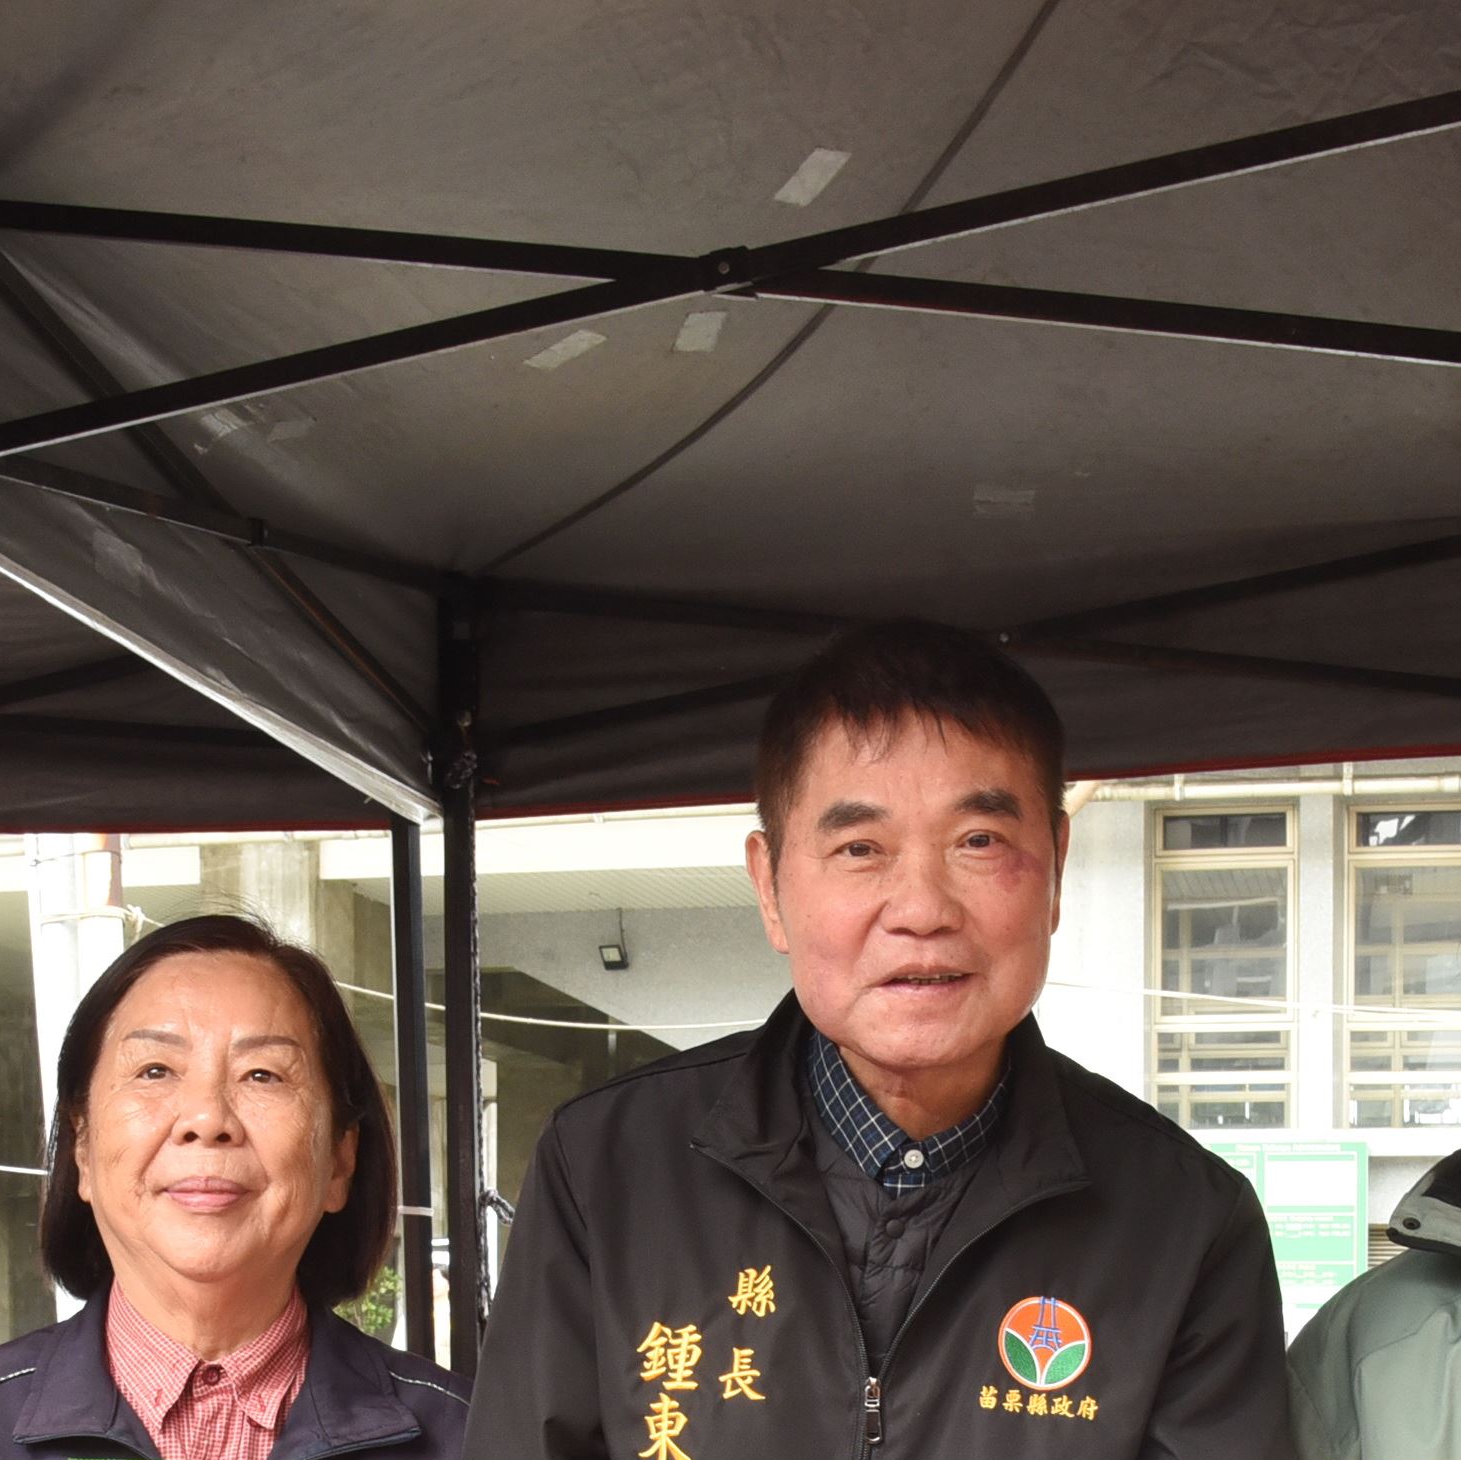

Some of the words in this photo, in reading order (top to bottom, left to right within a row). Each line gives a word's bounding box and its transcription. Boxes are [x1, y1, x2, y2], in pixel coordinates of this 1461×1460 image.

[718, 1265, 777, 1401] 縣長
[978, 1385, 1099, 1421] 苗栗縣政府
